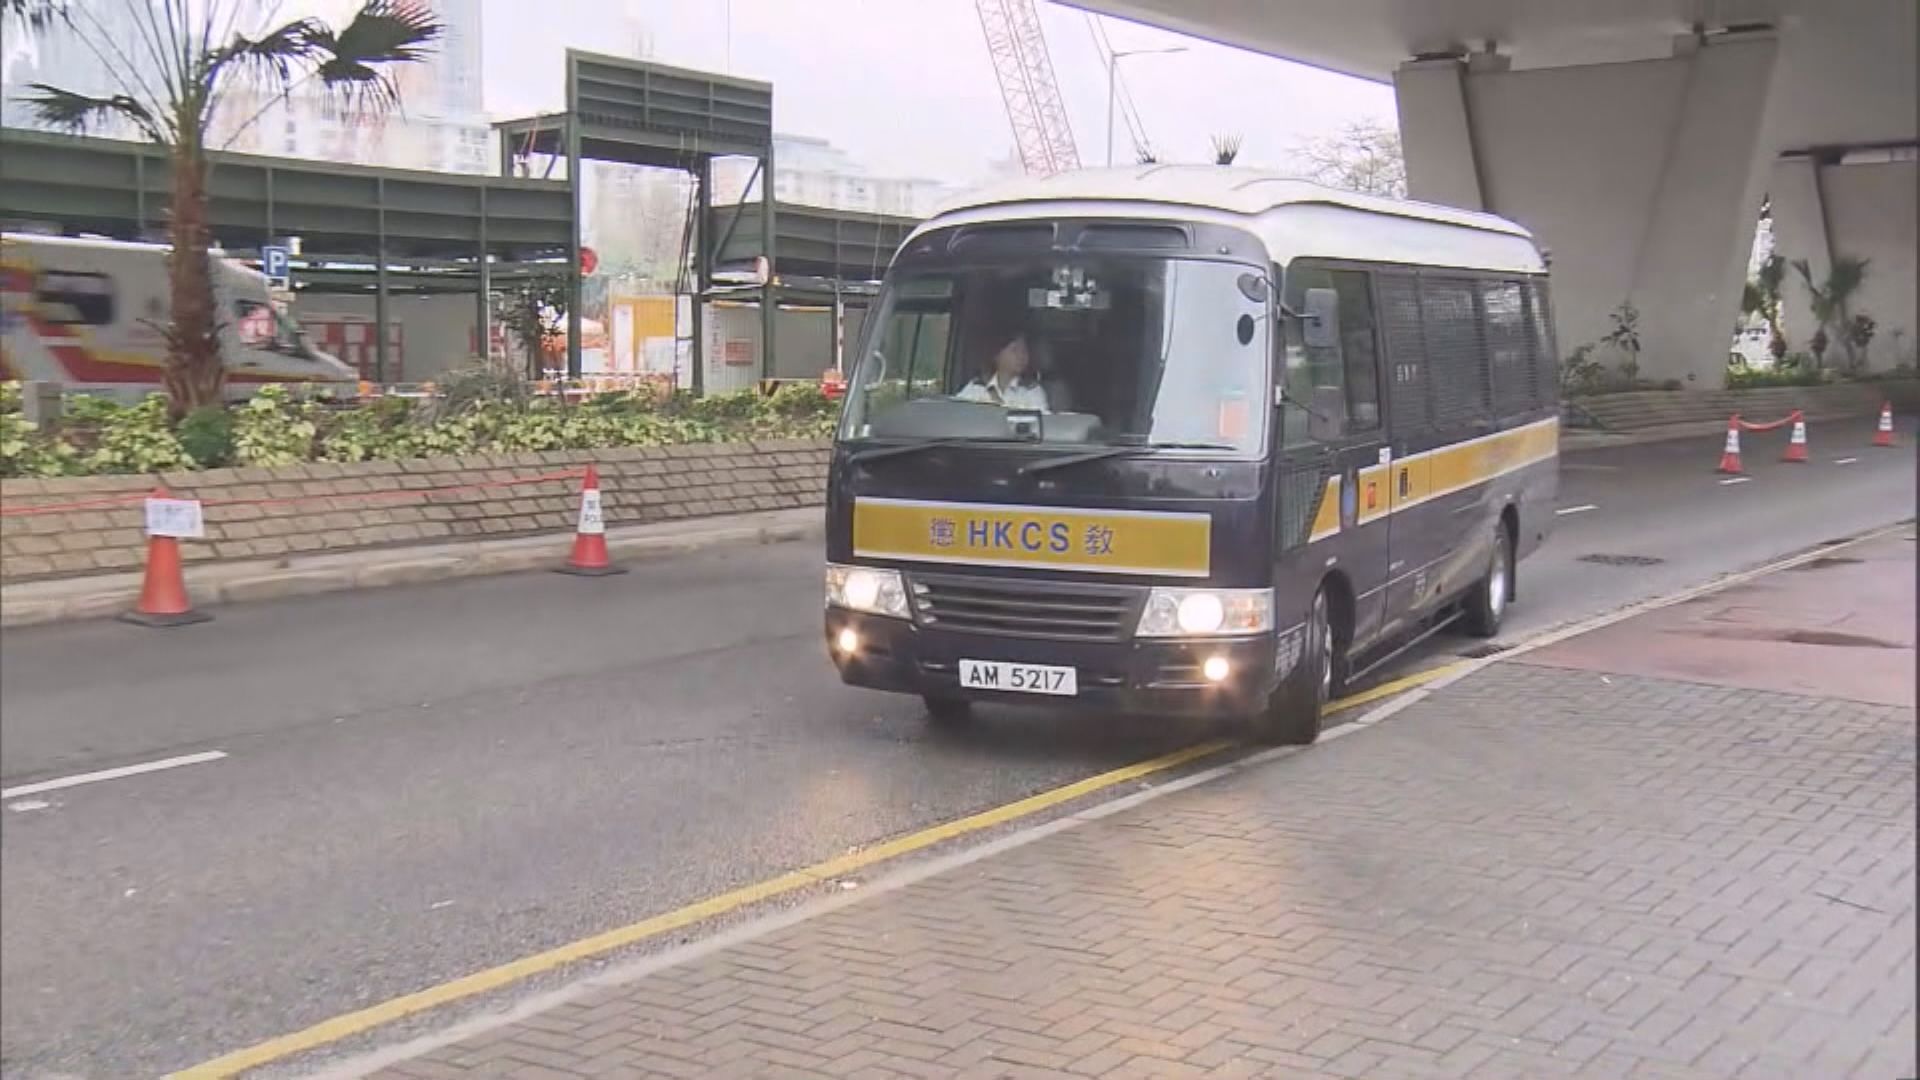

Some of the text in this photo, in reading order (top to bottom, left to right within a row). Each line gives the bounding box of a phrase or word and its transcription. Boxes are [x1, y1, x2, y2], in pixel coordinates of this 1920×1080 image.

[270, 250, 286, 273] P
[969, 520, 1070, 551] HKCS
[969, 664, 1066, 690] AM 5217
